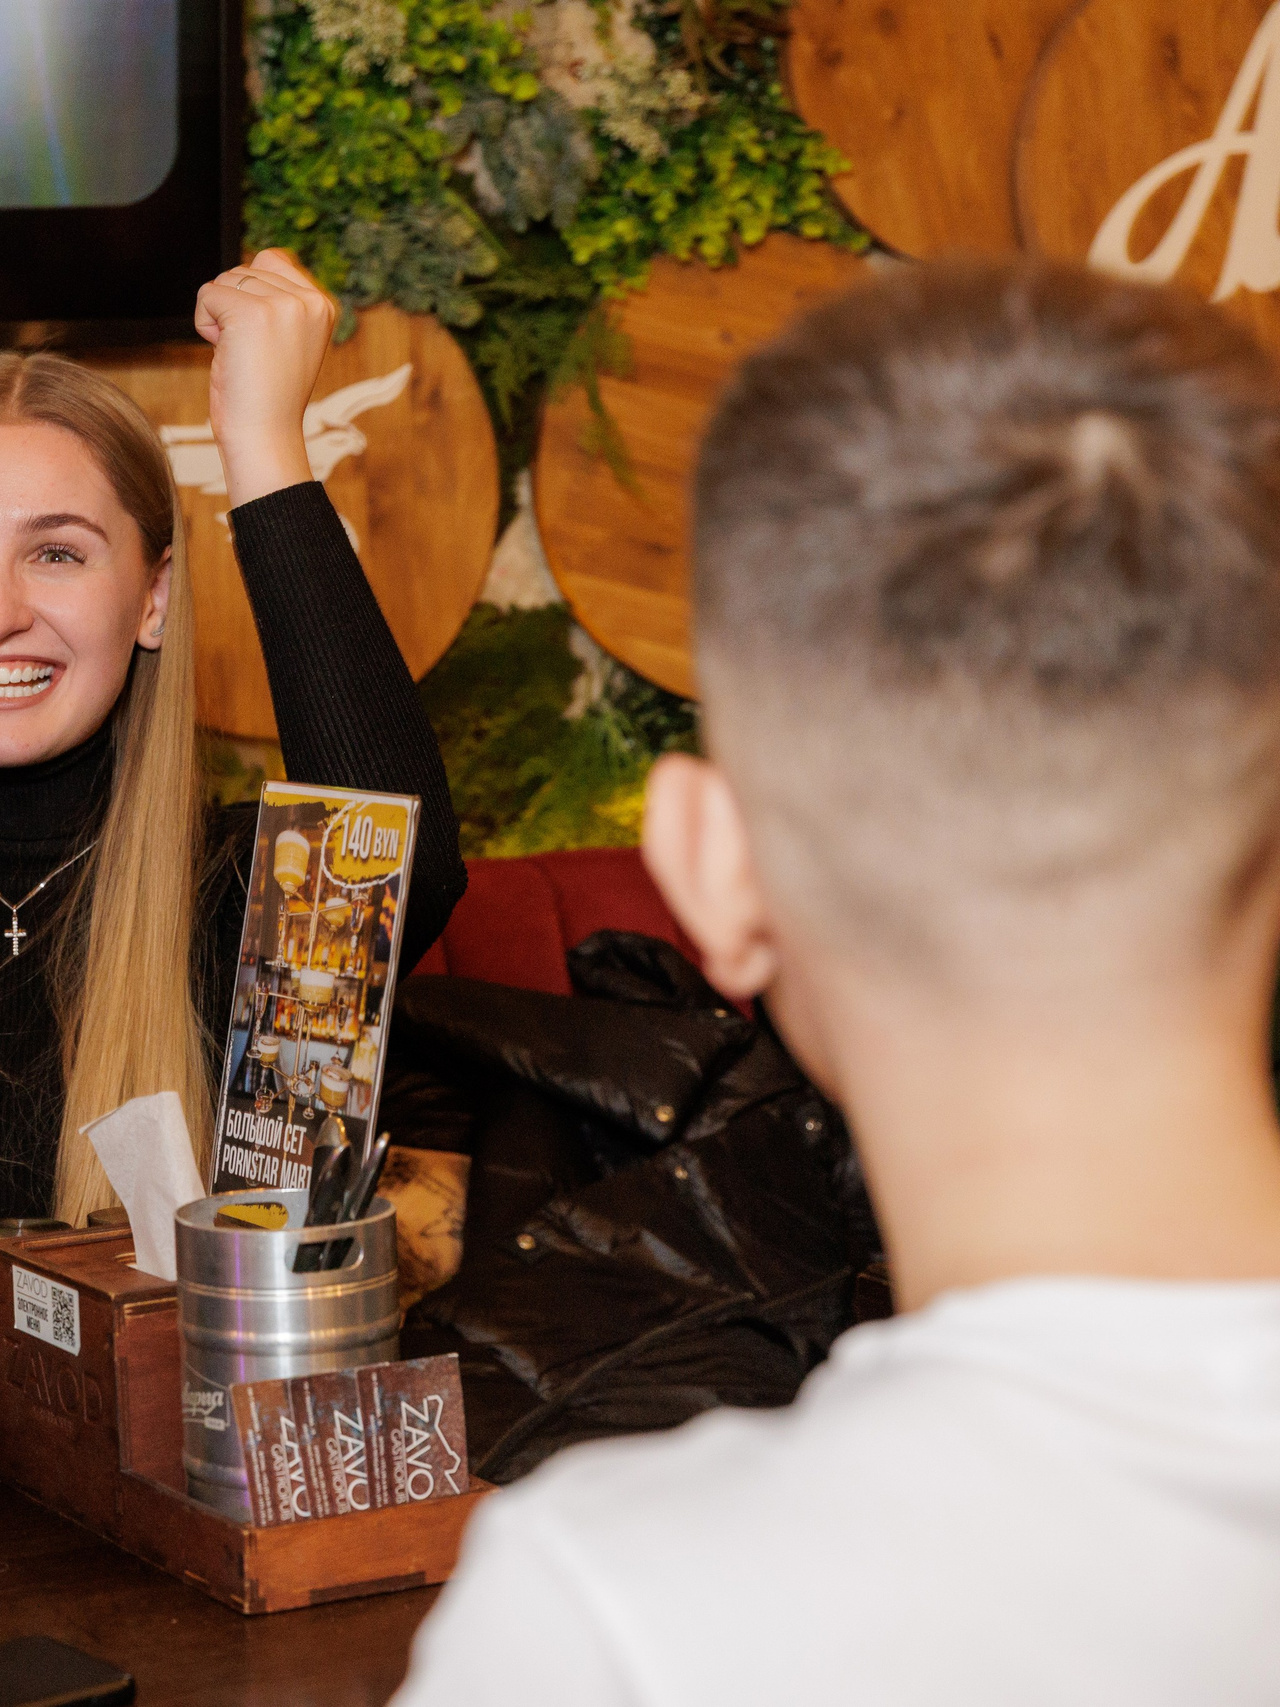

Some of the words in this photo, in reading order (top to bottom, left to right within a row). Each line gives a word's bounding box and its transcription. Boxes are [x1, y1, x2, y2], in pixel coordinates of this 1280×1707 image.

[341, 814, 373, 860] 140
[373, 826, 399, 860] BYN
[226, 1108, 284, 1150] БОЛЬШОЙ
[283, 1123, 307, 1155] СЕТ
[221, 1143, 279, 1186] PORNSTAR
[280, 1159, 313, 1189] MART
[16, 1270, 48, 1298] ZAVOD
[280, 1415, 311, 1518] ZAVO
[334, 1406, 370, 1511] ZAVO
[400, 1398, 434, 1501] ZAVO
